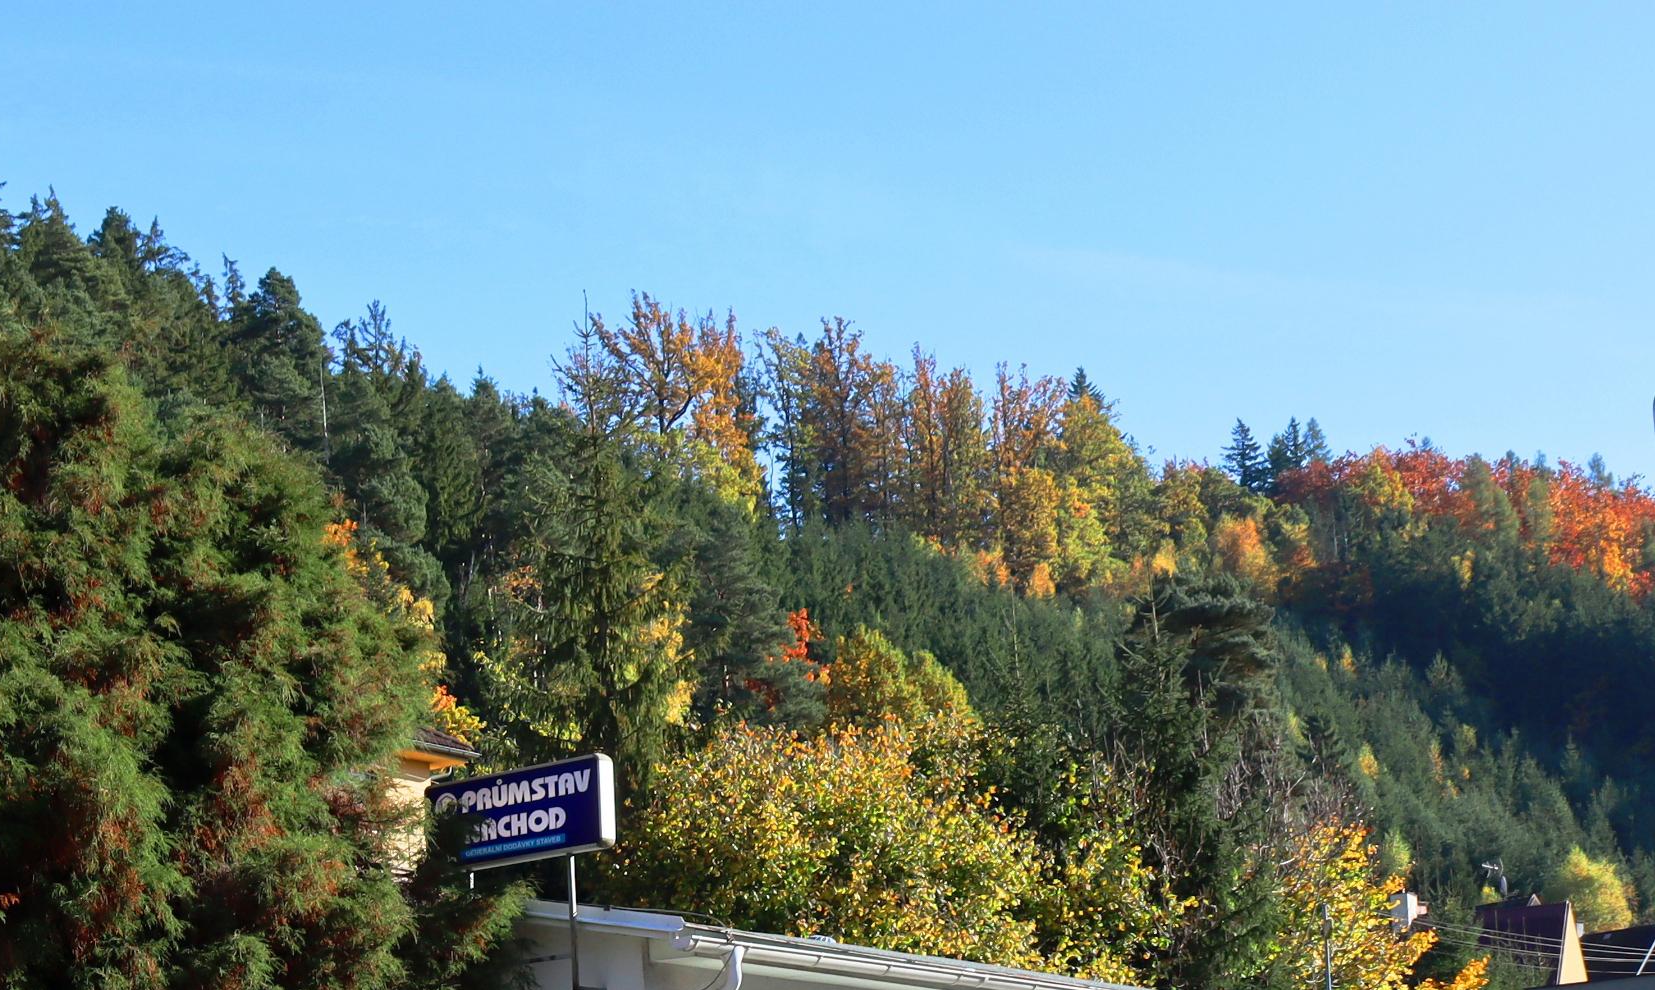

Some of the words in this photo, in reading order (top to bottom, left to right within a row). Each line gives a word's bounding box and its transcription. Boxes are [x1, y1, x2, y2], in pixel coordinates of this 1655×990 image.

[461, 768, 592, 814] PRŮMSTAV
[503, 839, 534, 851] DODÁVKY
[535, 834, 562, 846] STAVEB
